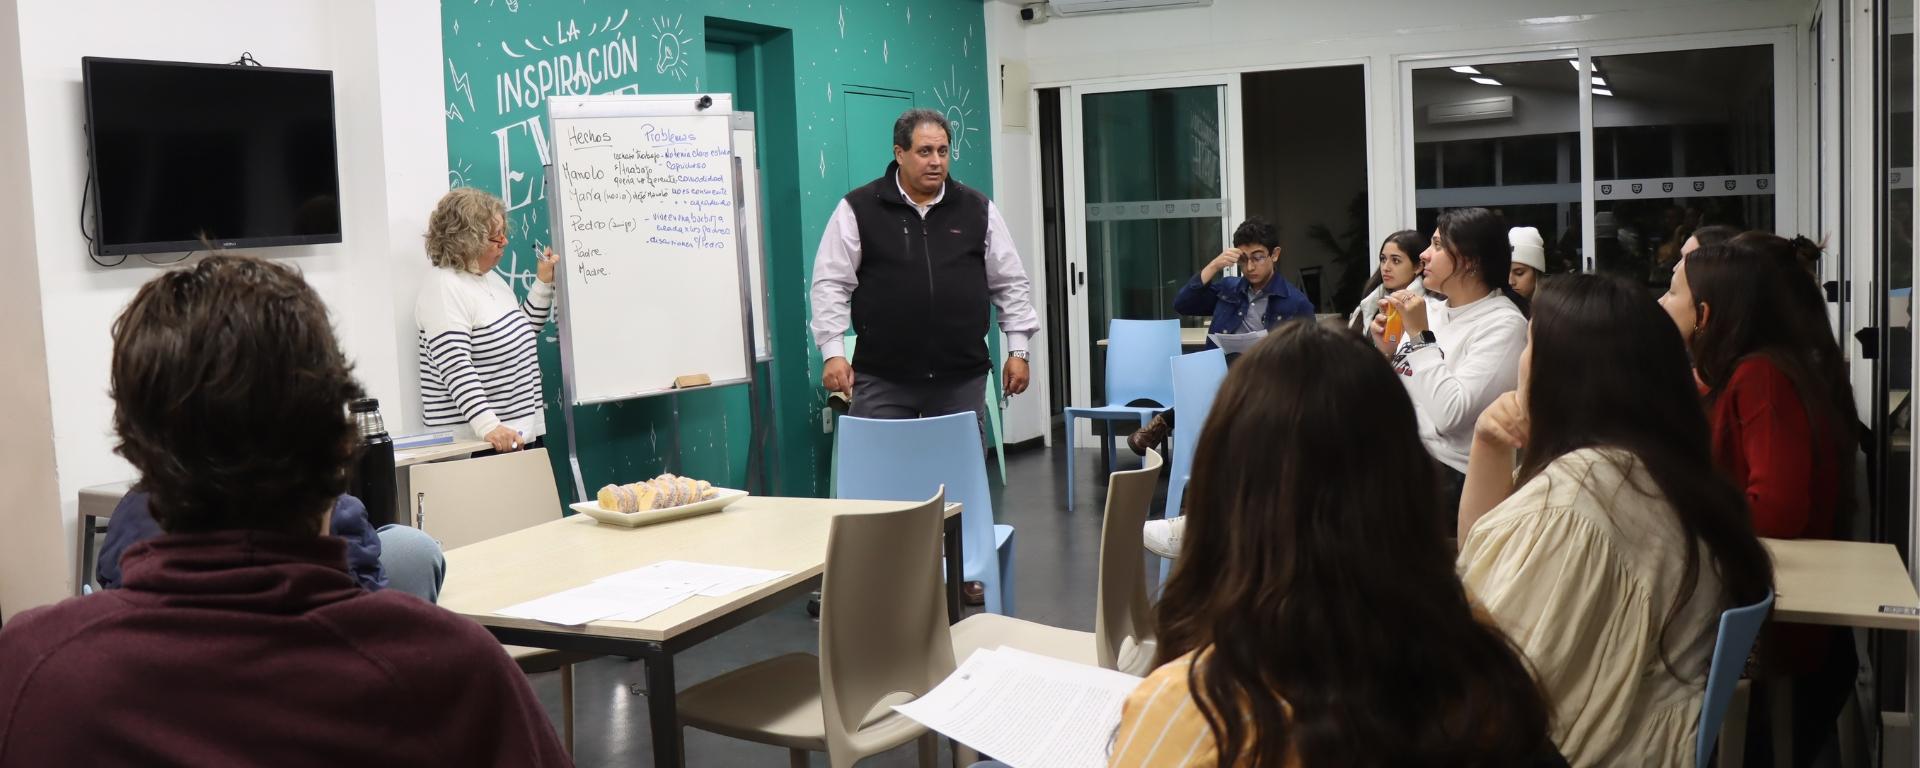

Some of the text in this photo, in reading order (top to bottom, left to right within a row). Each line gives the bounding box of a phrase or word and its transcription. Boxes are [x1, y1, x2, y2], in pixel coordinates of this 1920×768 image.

[558, 19, 580, 44] LA
[496, 32, 639, 115] INSPIRACIÓN
[567, 125, 612, 146] Hechos
[640, 123, 697, 142] Problemas
[562, 162, 604, 186] Manolo
[570, 214, 606, 231] Pedro
[571, 239, 602, 257] Padre
[578, 261, 607, 284] Madre
